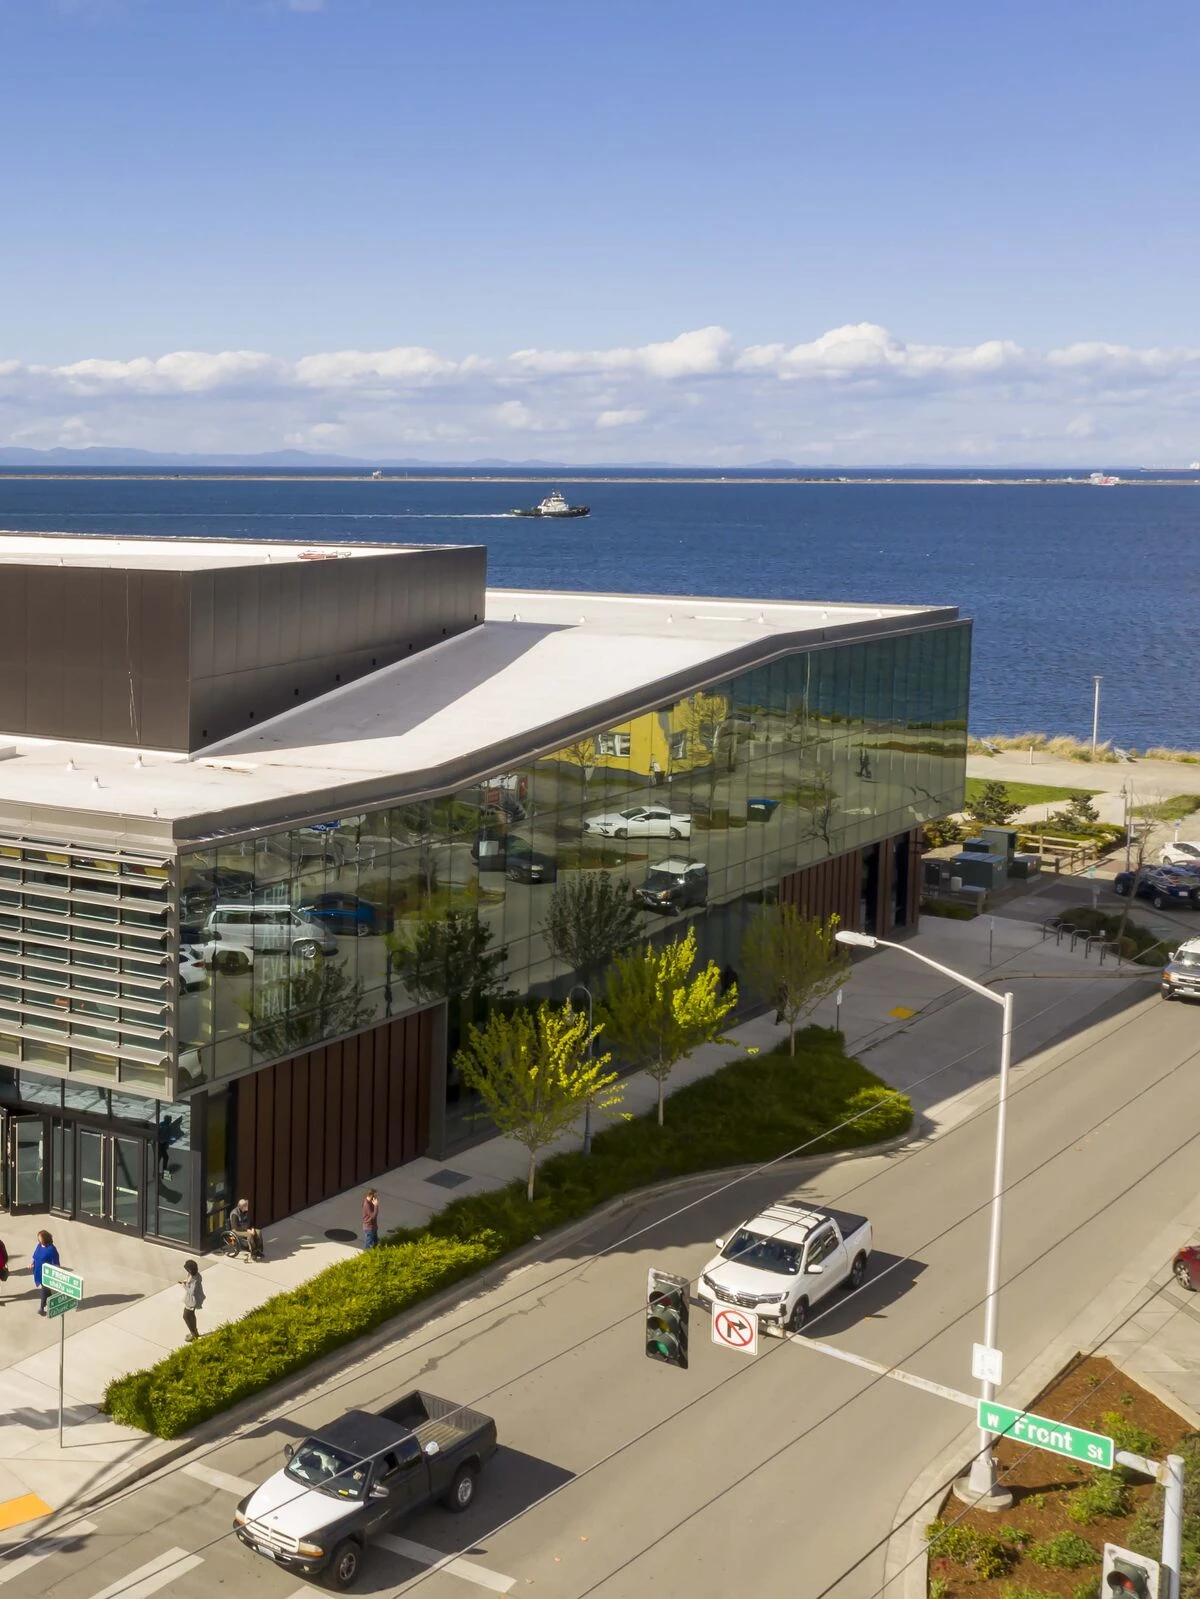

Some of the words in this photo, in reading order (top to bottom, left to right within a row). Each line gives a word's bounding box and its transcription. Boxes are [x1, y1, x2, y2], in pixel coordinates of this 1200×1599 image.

[987, 1412, 999, 1428] W
[1014, 1415, 1073, 1451] Front
[1087, 1443, 1104, 1461] St
